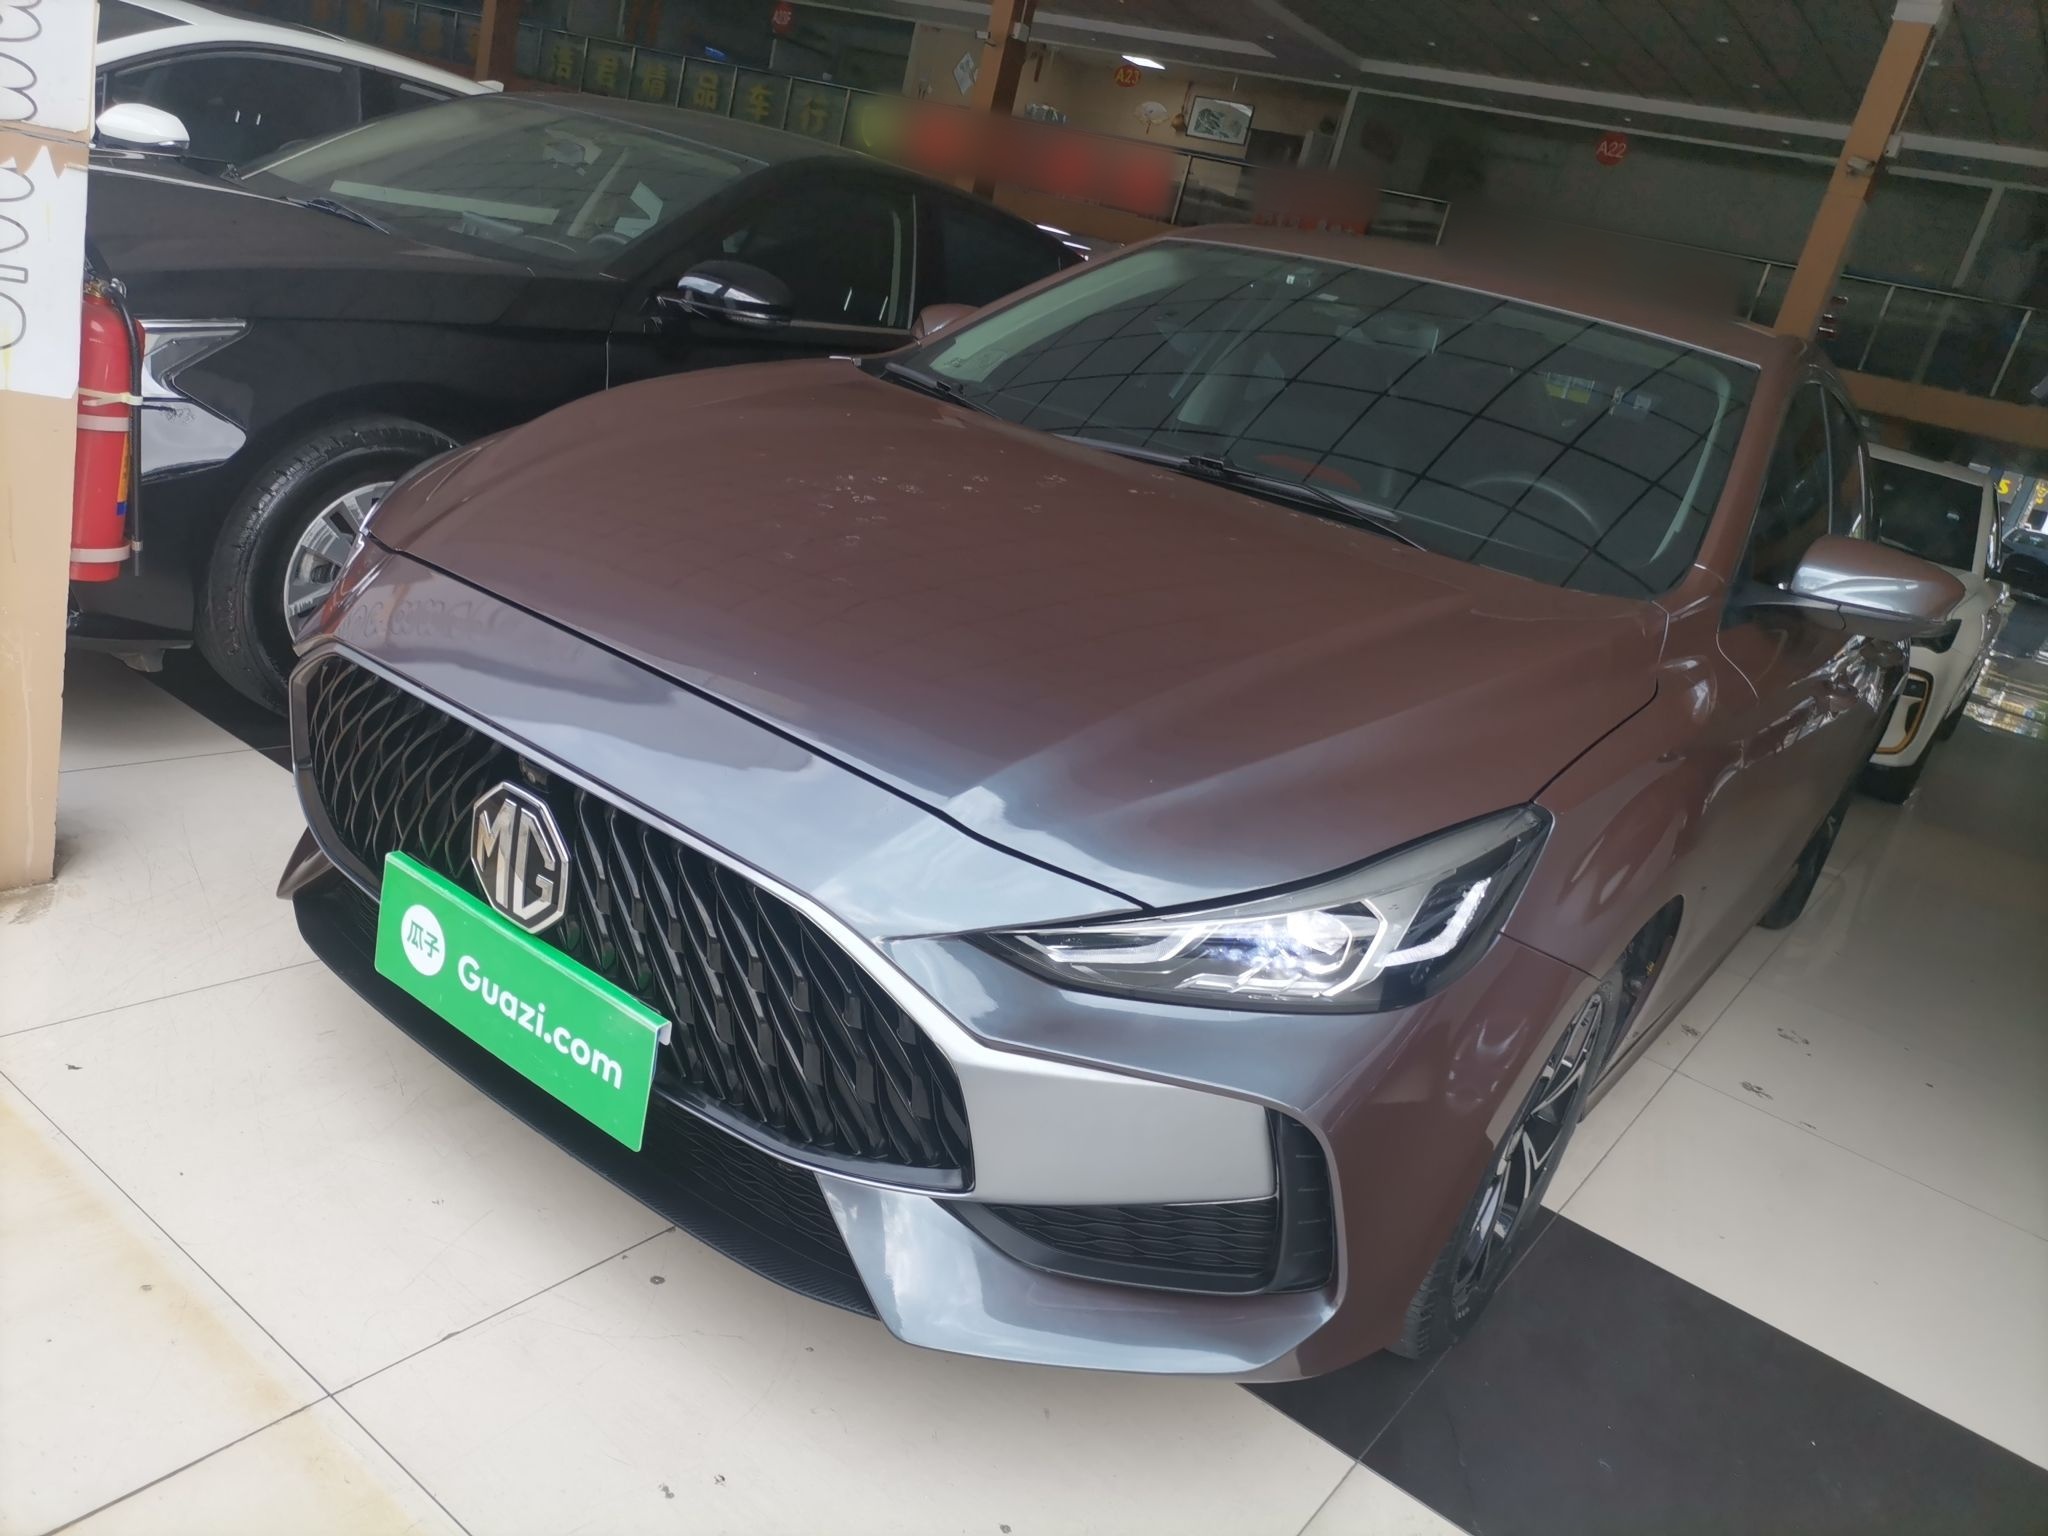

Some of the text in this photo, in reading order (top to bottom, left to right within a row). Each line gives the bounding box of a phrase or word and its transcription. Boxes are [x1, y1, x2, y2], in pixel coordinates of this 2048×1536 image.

[1595, 139, 1627, 158] A22
[476, 798, 556, 921] MG
[406, 921, 440, 958] 瓜子
[457, 954, 623, 1090] Guazi.com
